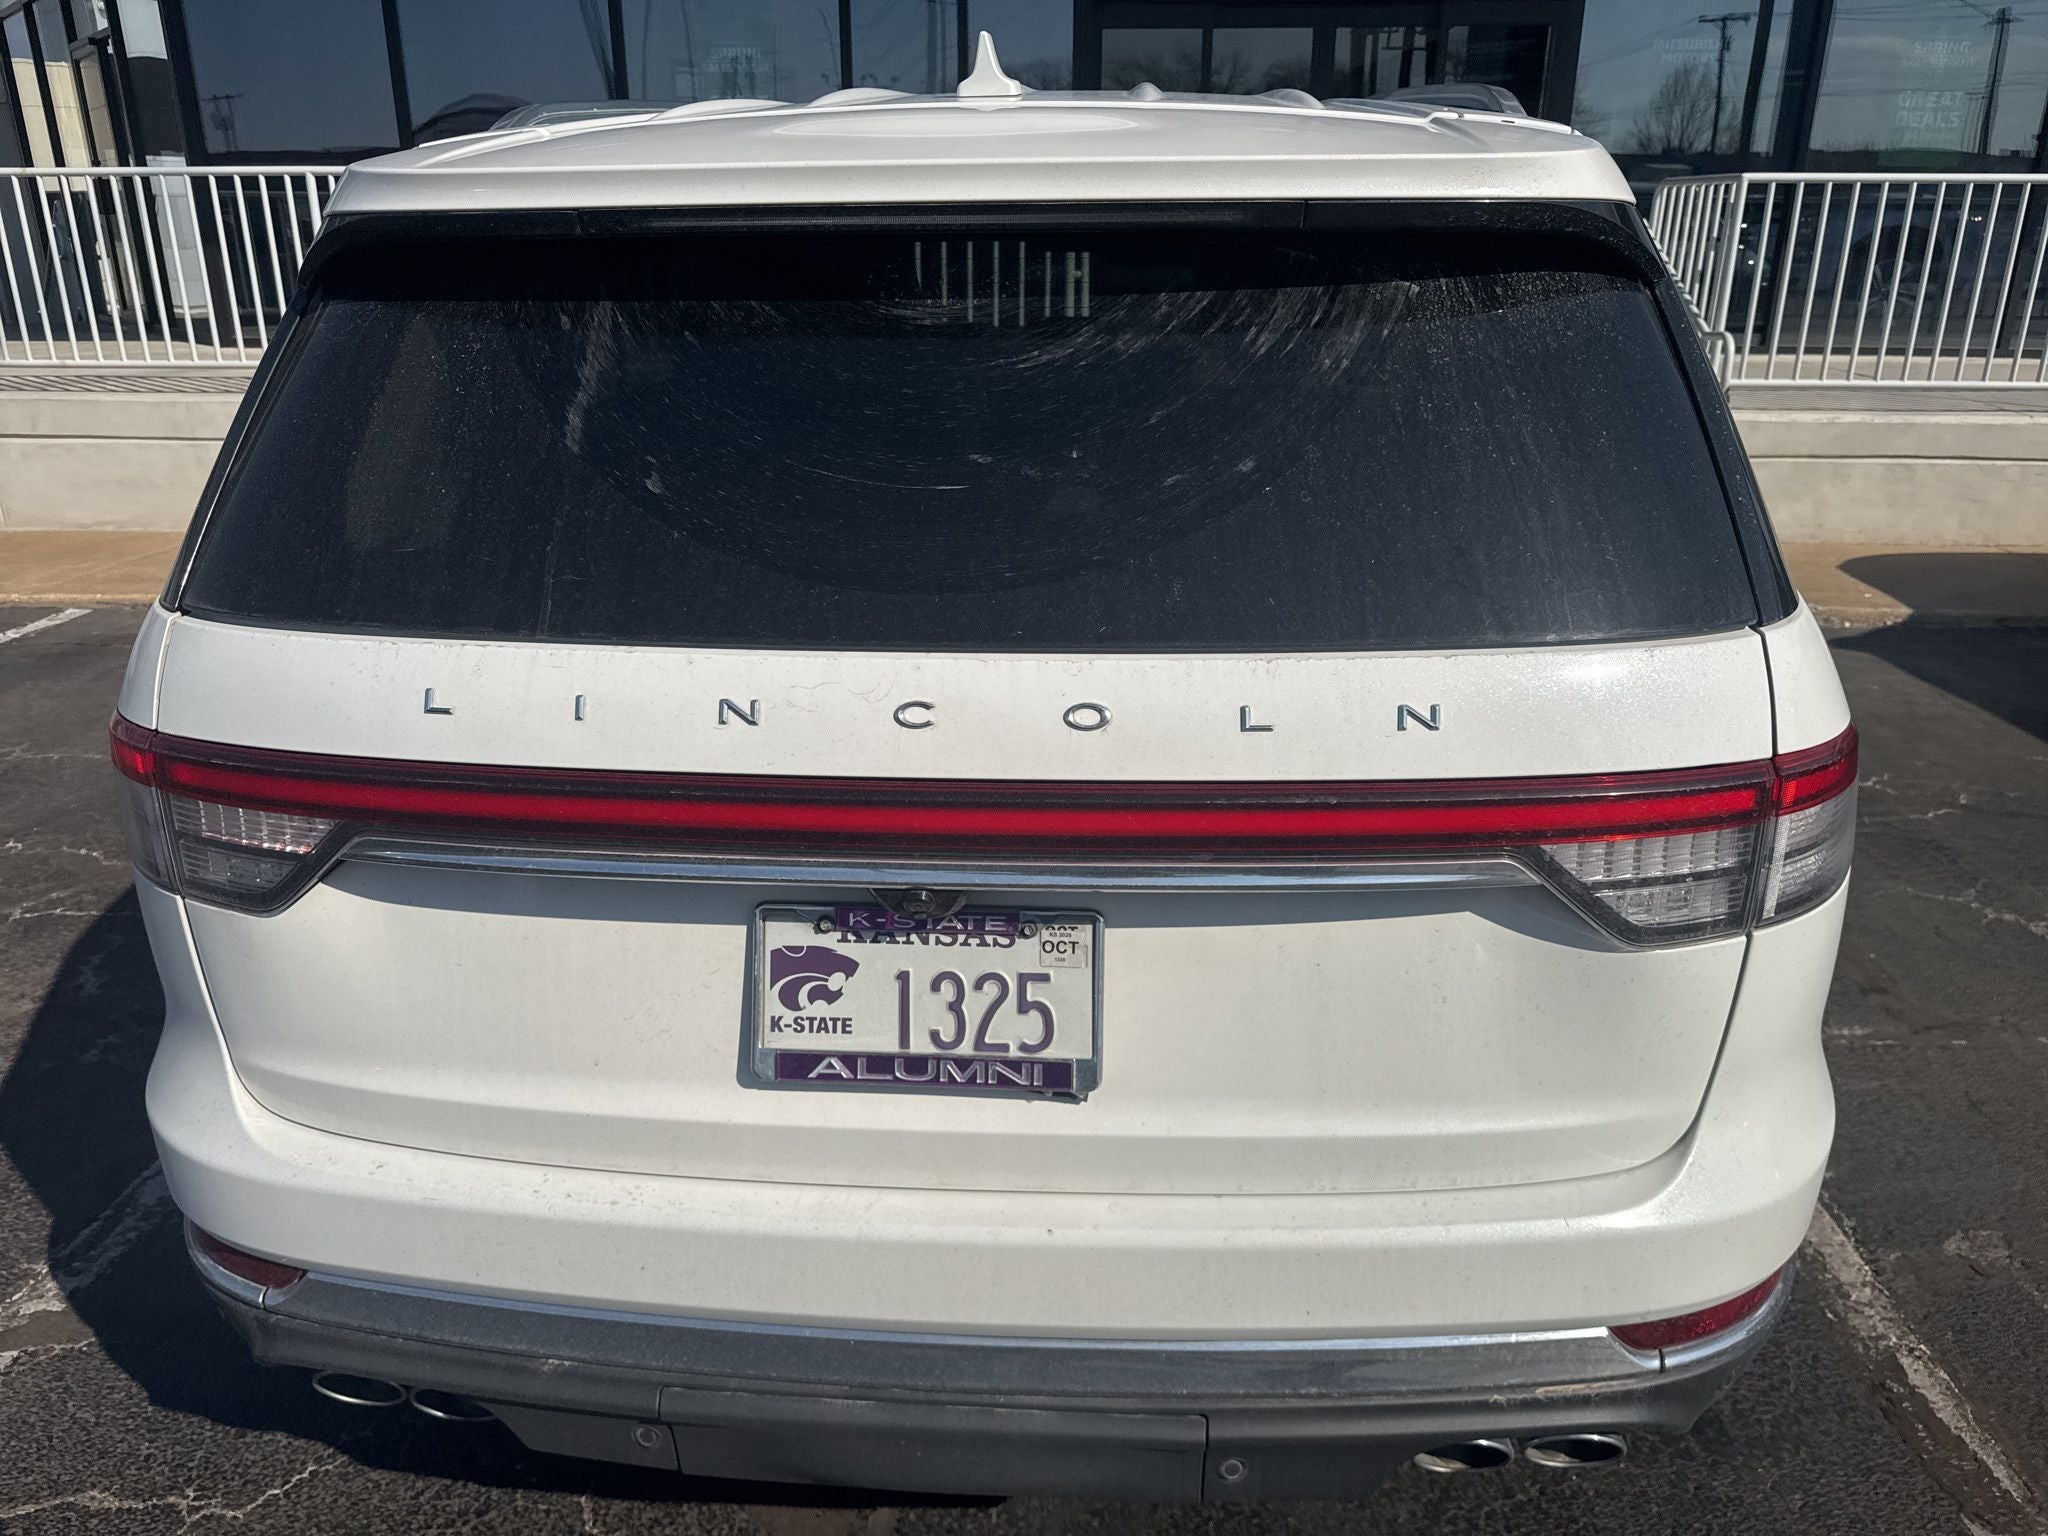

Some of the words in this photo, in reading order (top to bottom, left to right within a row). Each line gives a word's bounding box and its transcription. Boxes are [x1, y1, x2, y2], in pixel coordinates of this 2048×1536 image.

[424, 688, 1440, 732] LINCOLN
[848, 911, 1008, 931] K-STATE
[1042, 940, 1079, 954] OCT
[895, 969, 1056, 1054] 1325
[769, 1015, 853, 1035] K-STATE
[806, 1056, 1044, 1087] ALUMNI
